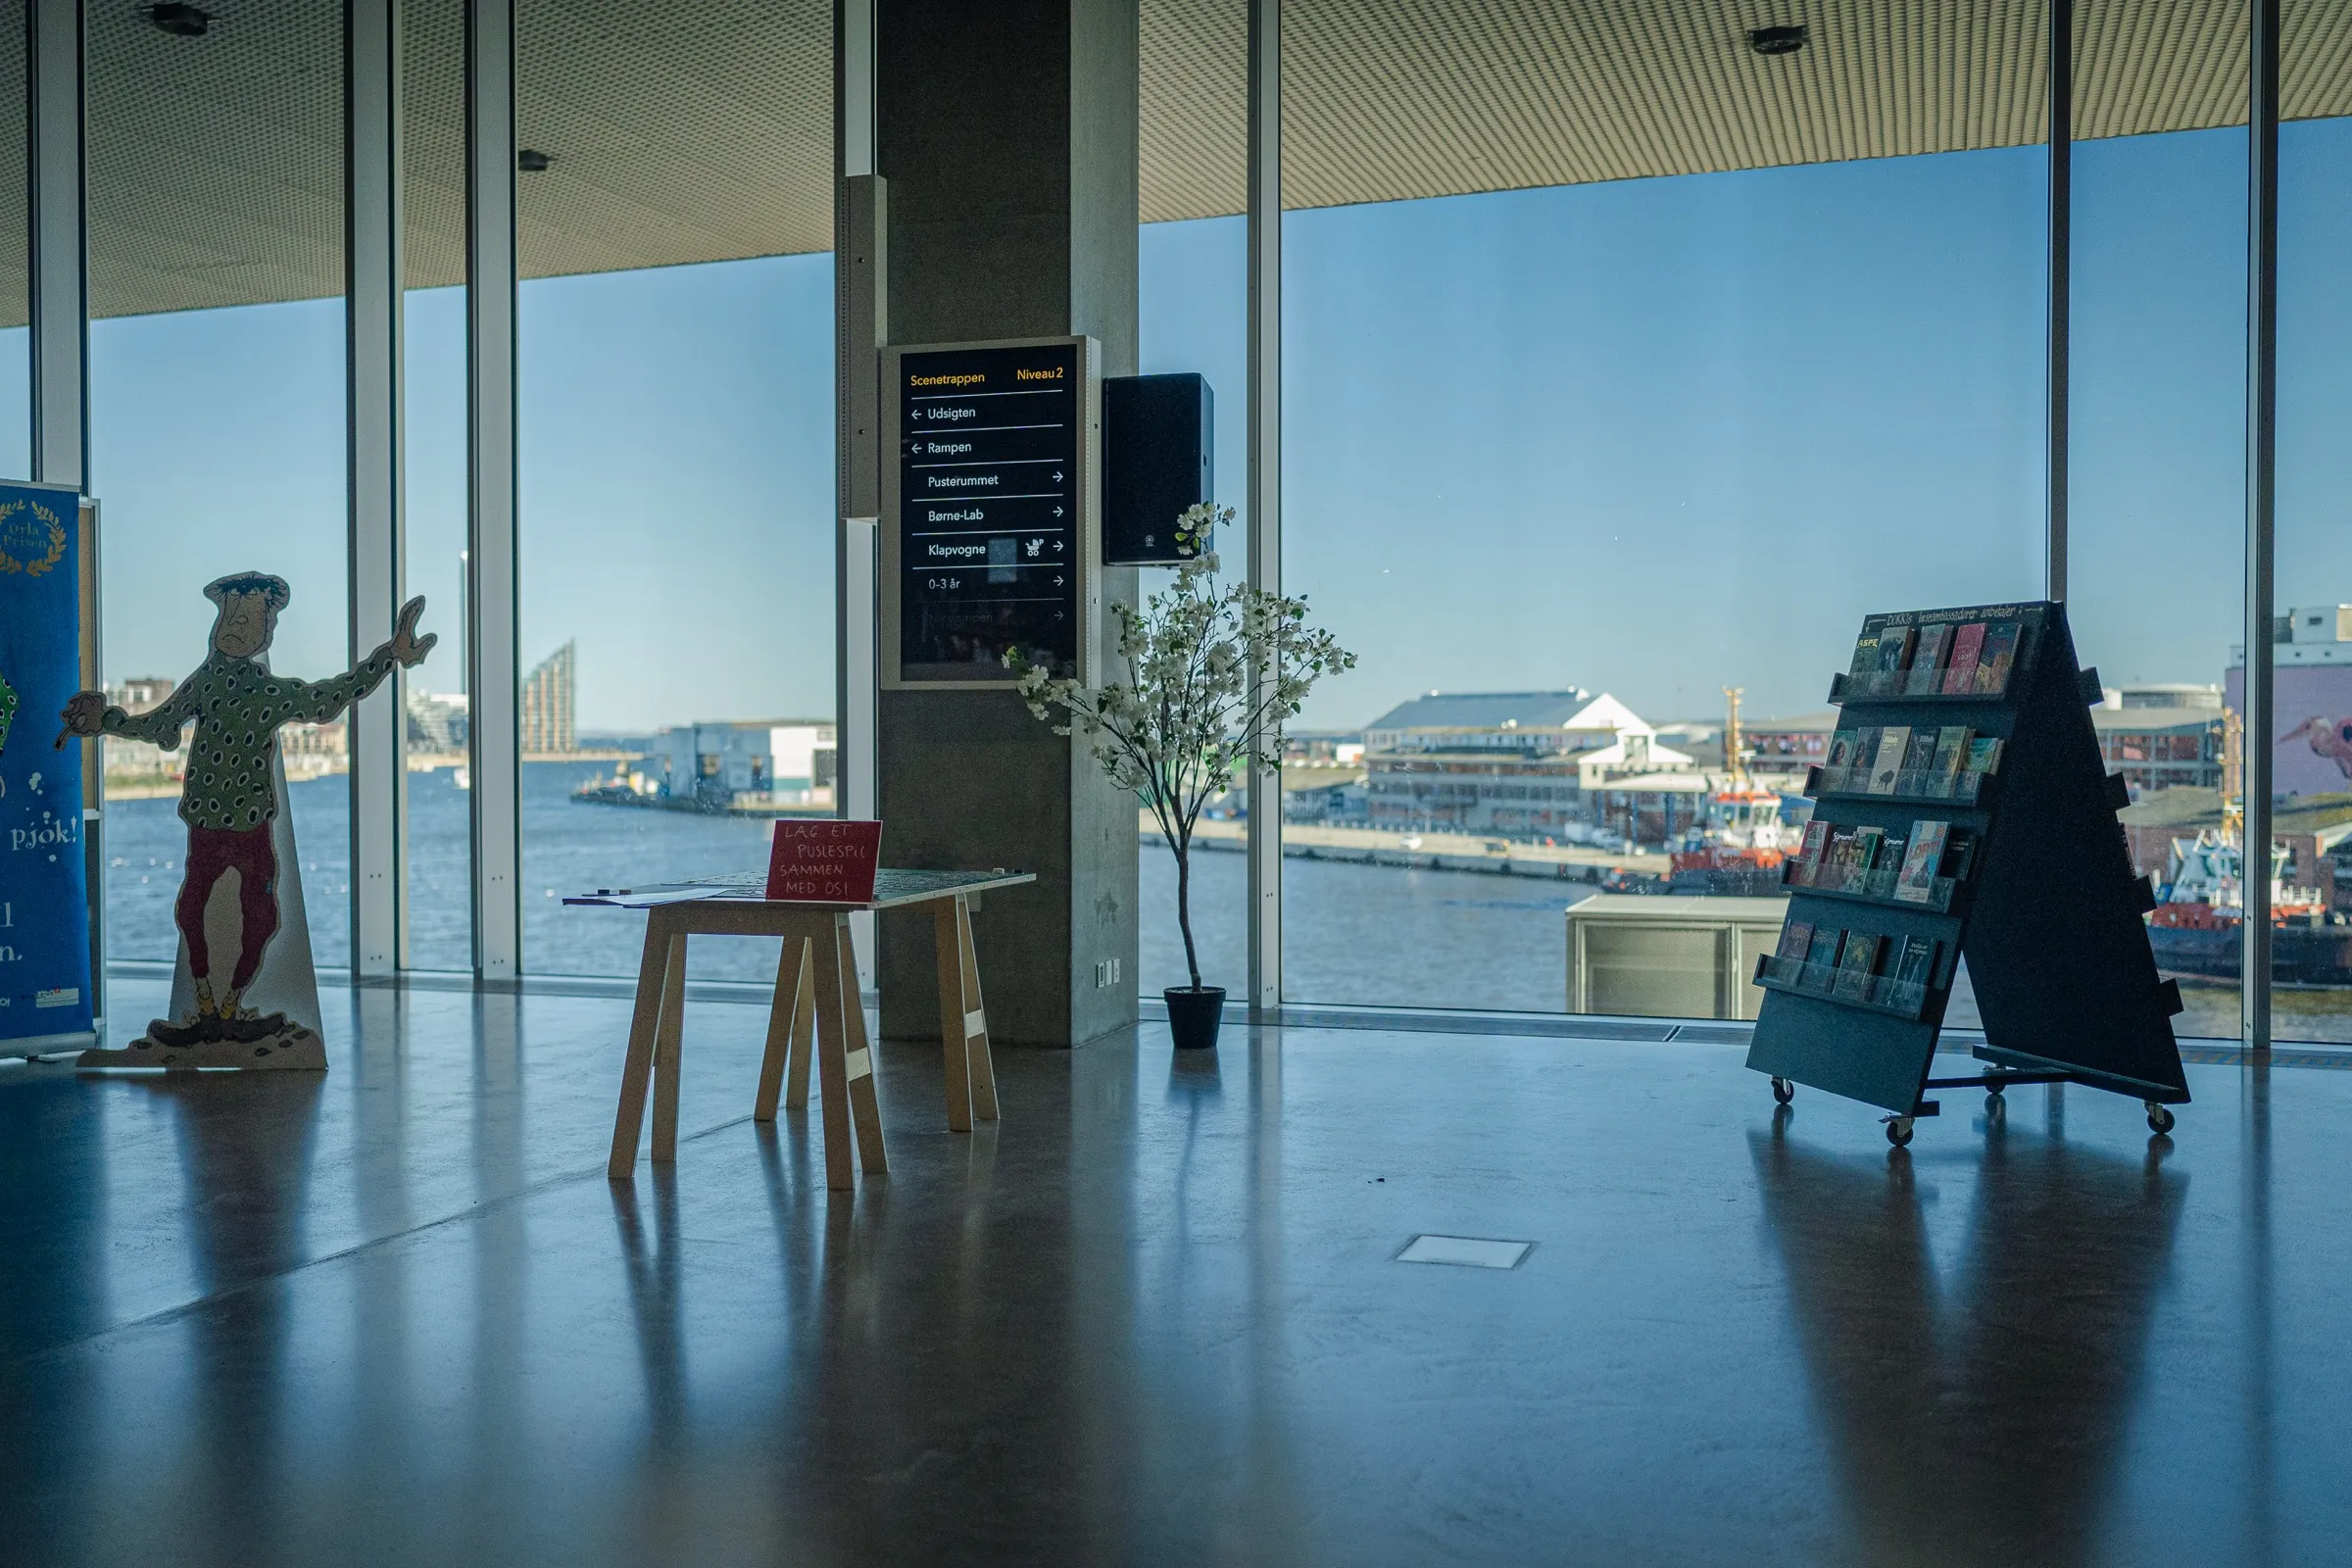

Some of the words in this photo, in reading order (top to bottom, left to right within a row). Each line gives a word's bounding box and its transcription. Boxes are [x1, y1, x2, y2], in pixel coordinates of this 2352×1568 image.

[910, 373, 985, 387] Scenetrappen
[1016, 368, 1055, 380] Niveau
[1055, 367, 1063, 379] 2
[927, 407, 976, 420] Udsigten
[927, 442, 972, 456] Rampen
[928, 474, 1000, 488] Pusterummet
[928, 508, 984, 521] Børne-Lab
[928, 544, 986, 558] Klapvogne
[950, 577, 961, 589] år
[10, 815, 77, 852] pjok!
[785, 825, 818, 838] LAG
[831, 824, 854, 837] ET
[780, 864, 844, 877] SAMMEN
[786, 882, 816, 894] MED
